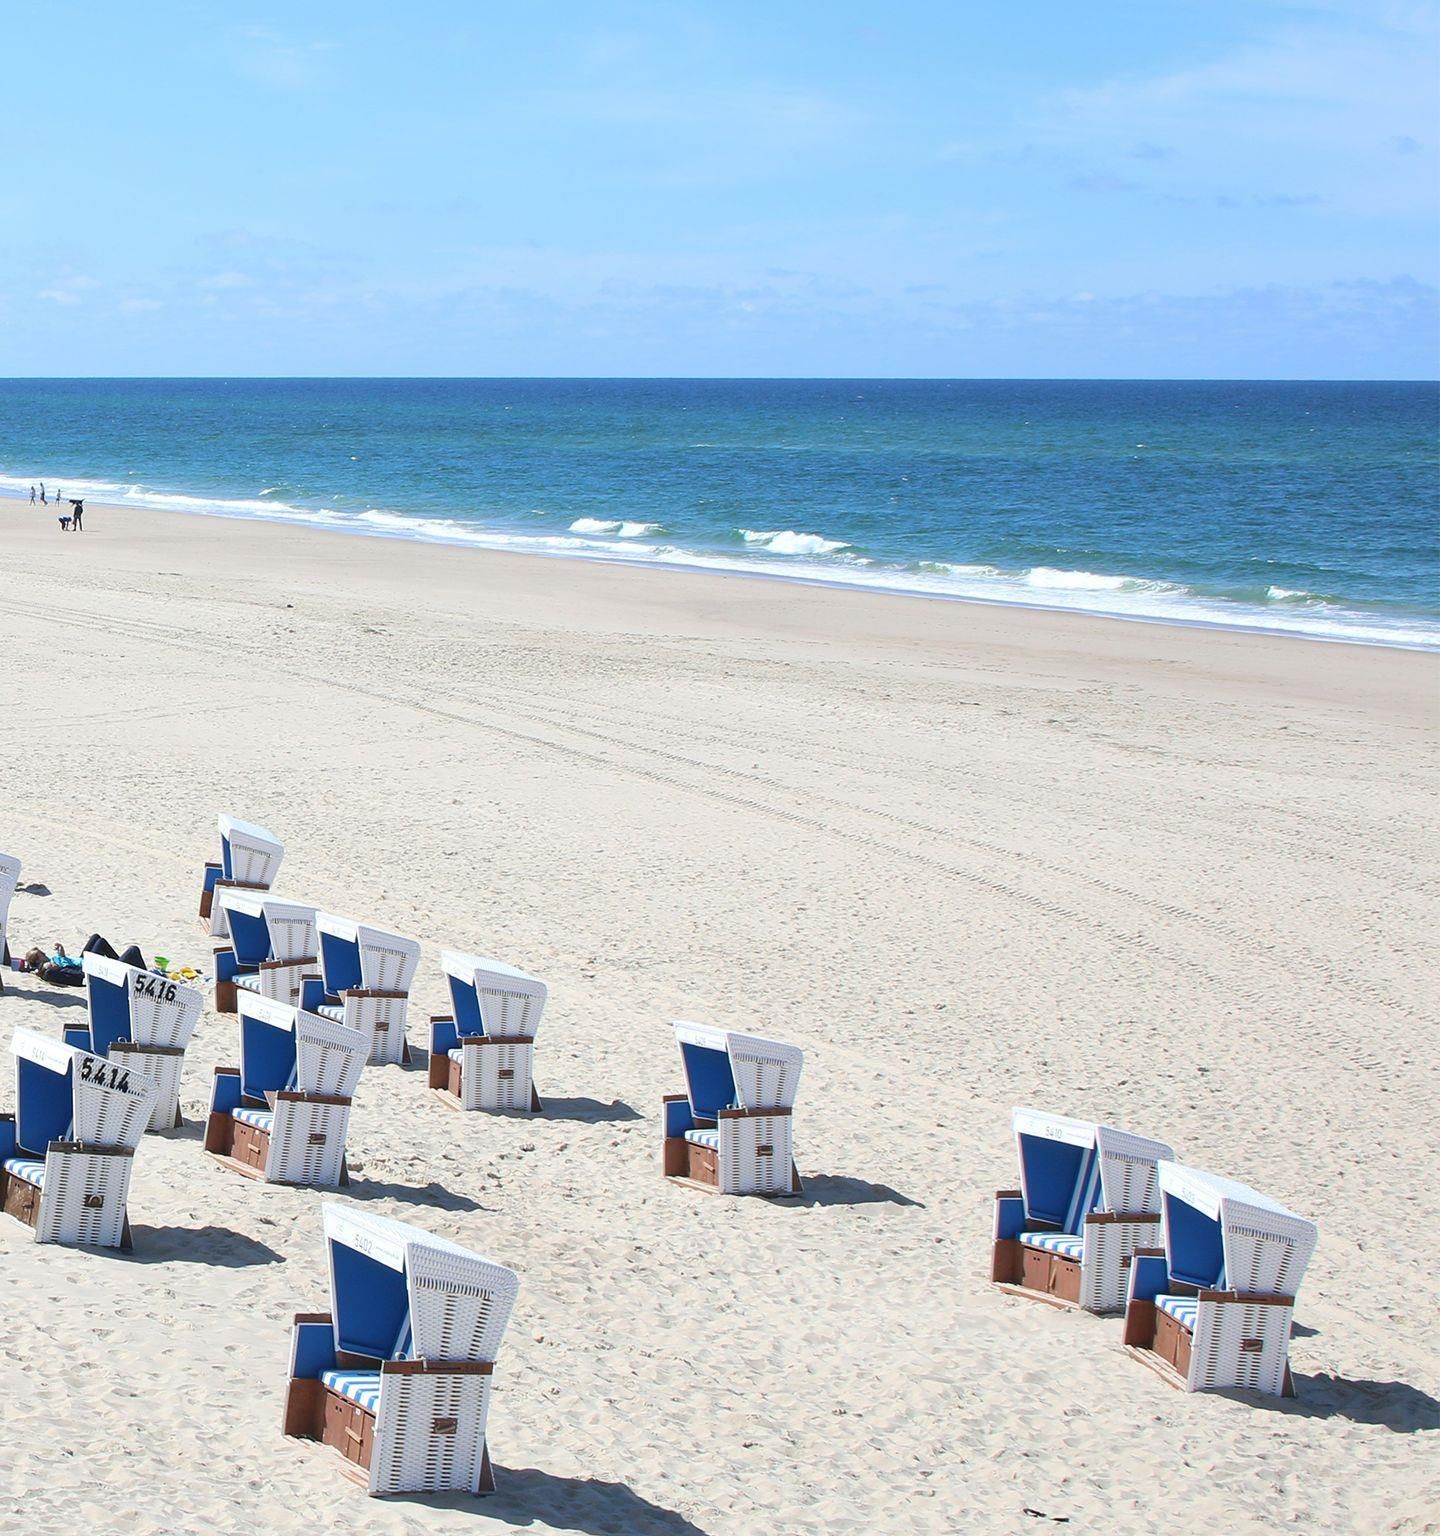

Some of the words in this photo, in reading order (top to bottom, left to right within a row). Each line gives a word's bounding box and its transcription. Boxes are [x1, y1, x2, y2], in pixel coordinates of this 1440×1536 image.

[134, 974, 178, 1002] 5416
[80, 1055, 131, 1094] 5414
[353, 1234, 373, 1254] 5402
